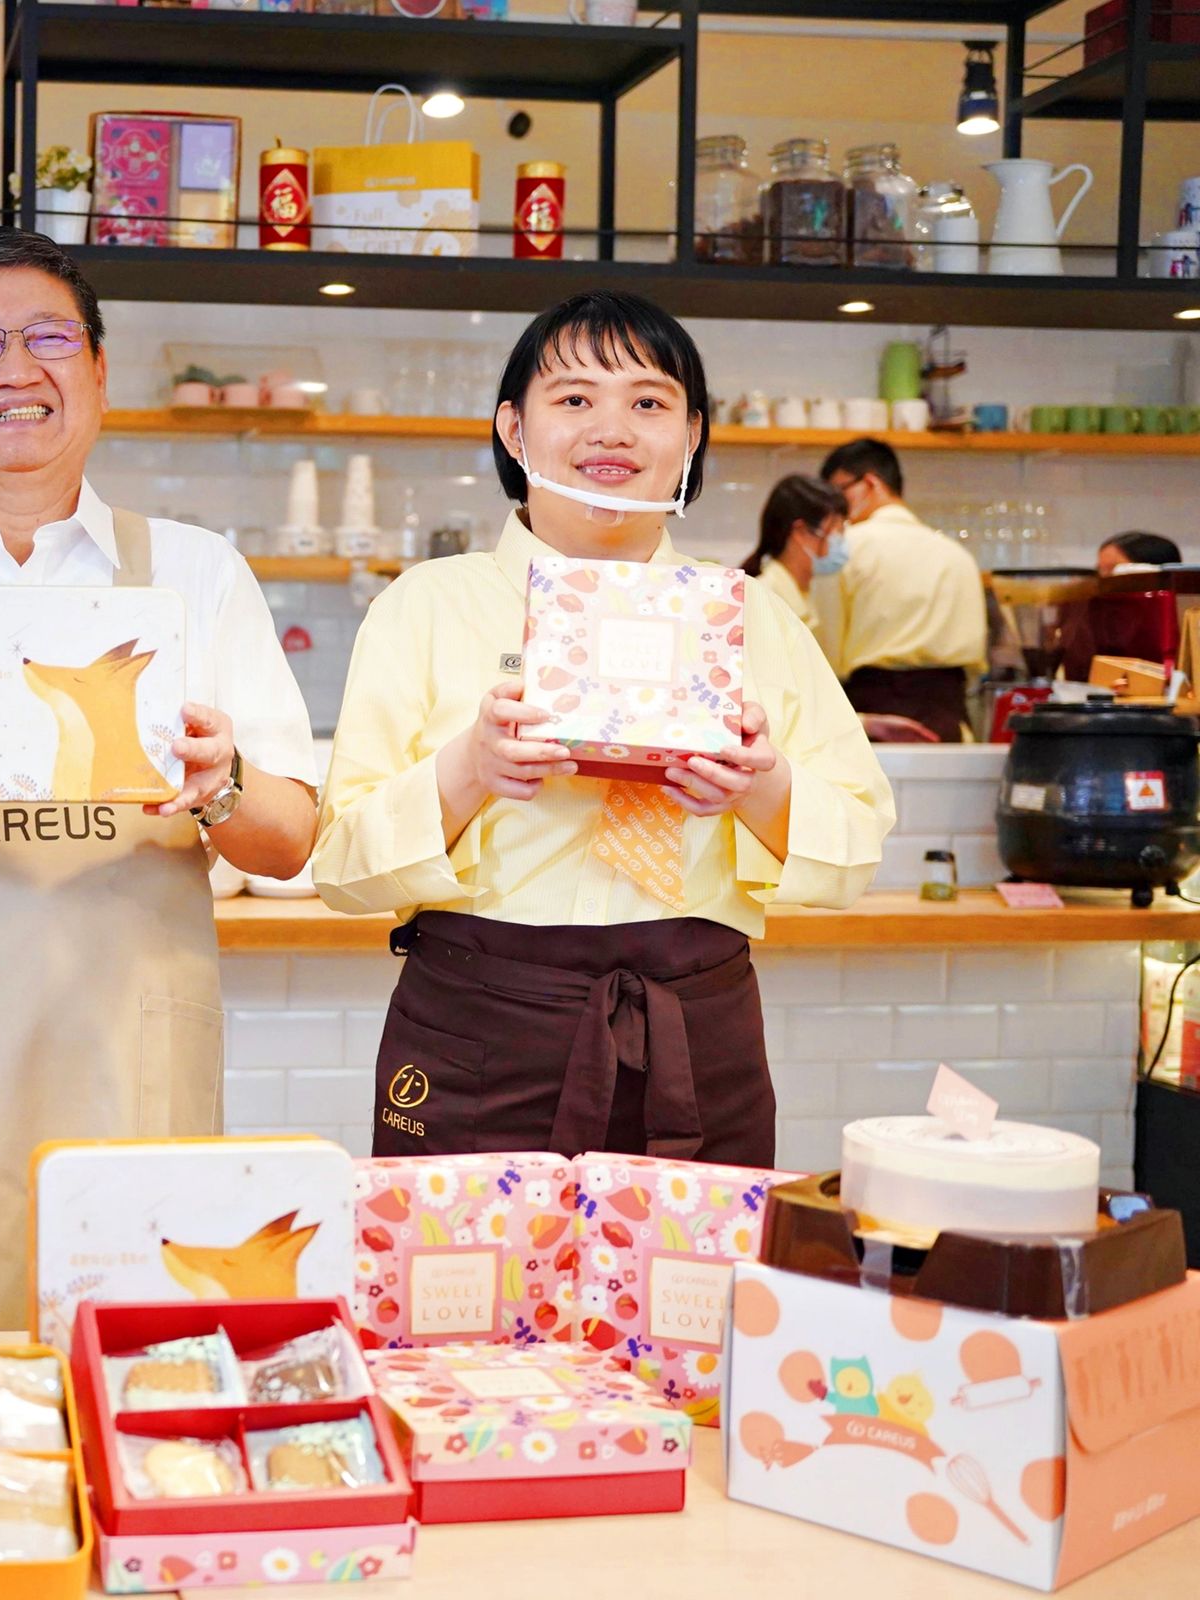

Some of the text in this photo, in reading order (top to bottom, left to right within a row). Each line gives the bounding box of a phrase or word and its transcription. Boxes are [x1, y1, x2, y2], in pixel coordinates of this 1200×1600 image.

[270, 186, 298, 219] 福
[526, 201, 555, 233] 福
[626, 812, 653, 843] CAREUS
[603, 829, 630, 860] CAREUS
[634, 844, 662, 876] CAREUS
[382, 1107, 425, 1137] CAREUS
[422, 1283, 483, 1300] SWEET
[422, 1305, 484, 1321] LOVE
[867, 1425, 916, 1450] CAREUS
